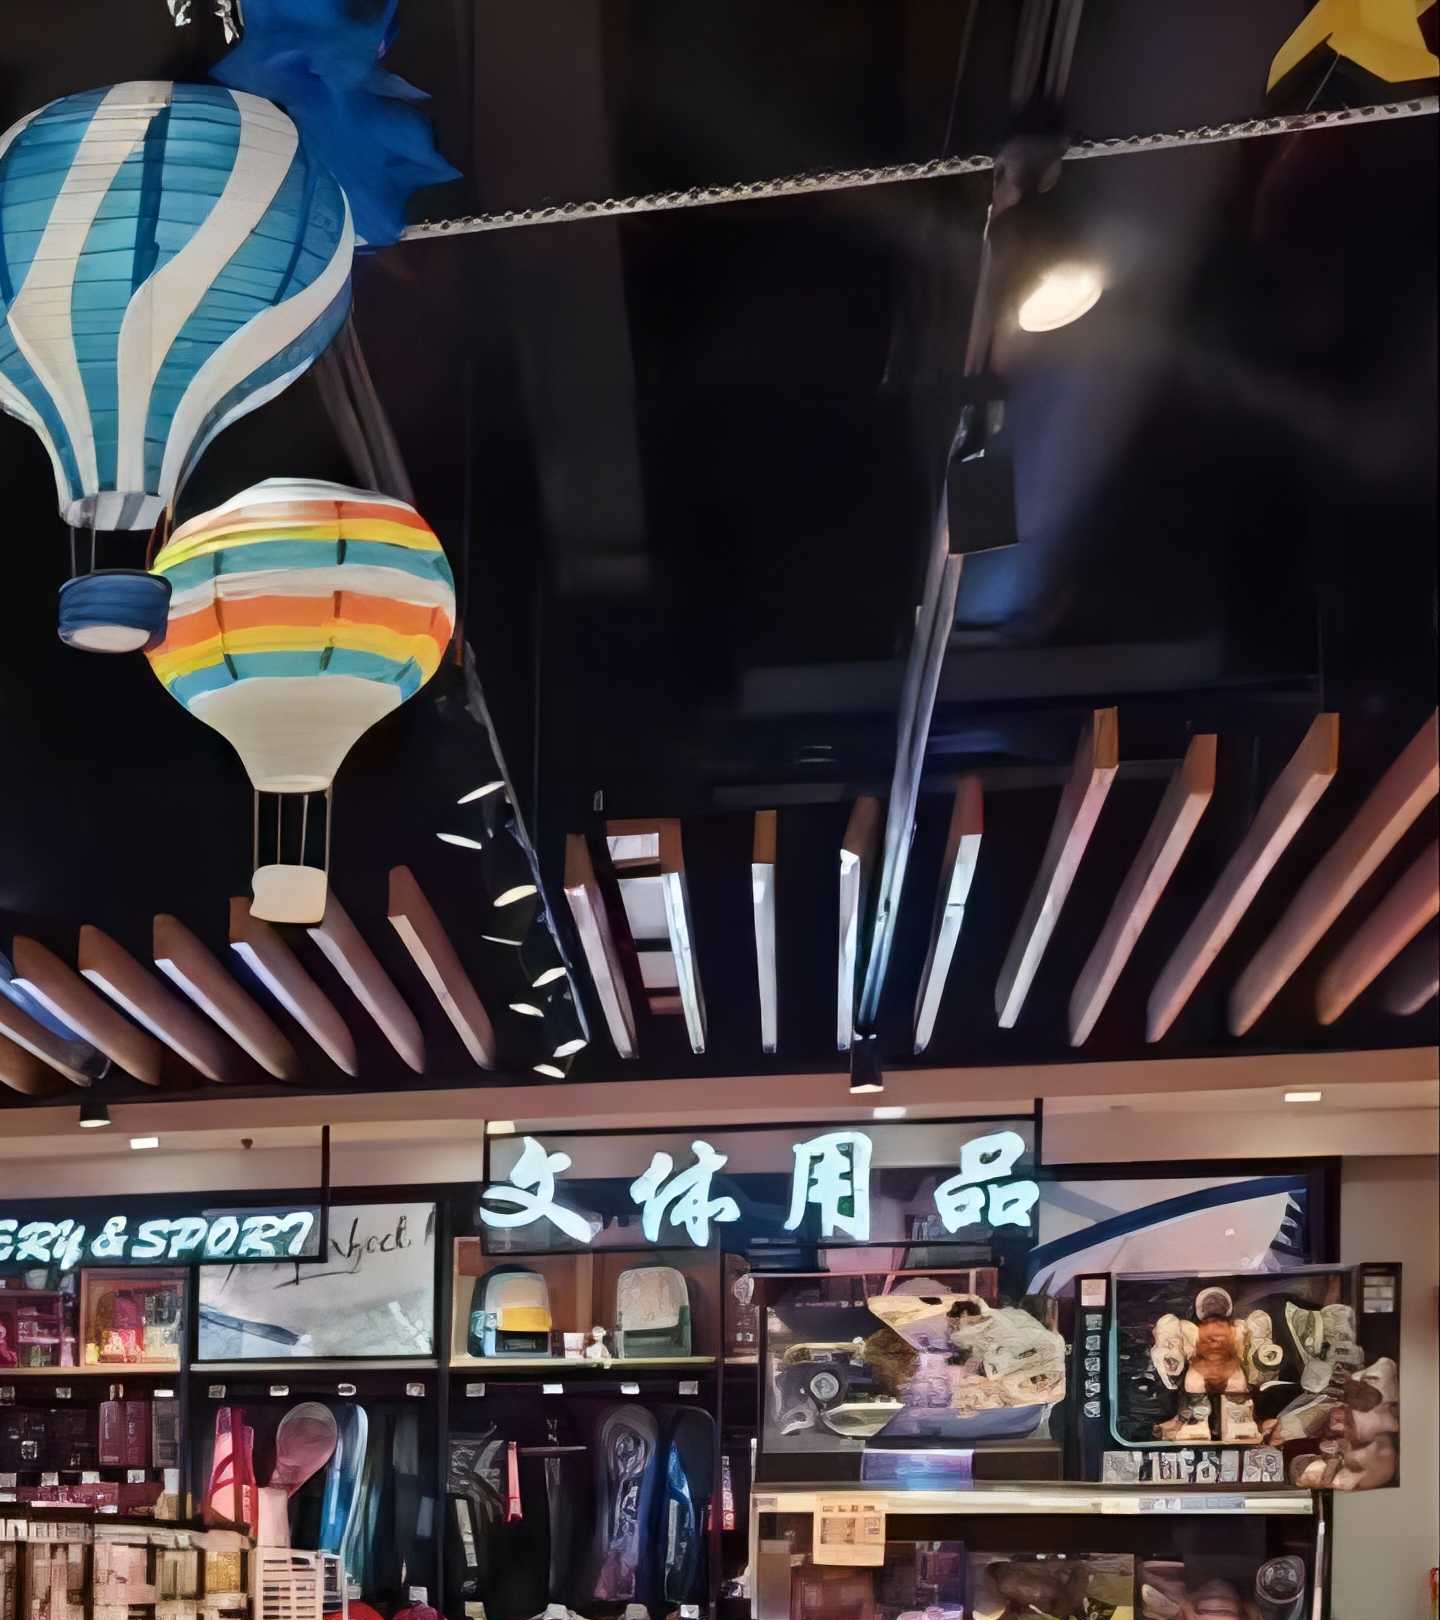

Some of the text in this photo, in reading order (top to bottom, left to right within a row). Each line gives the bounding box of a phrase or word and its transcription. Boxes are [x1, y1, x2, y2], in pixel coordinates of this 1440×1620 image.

[479, 1130, 1041, 1247] 文体用品
[90, 1214, 129, 1258] &
[130, 1210, 315, 1258] SPORT
